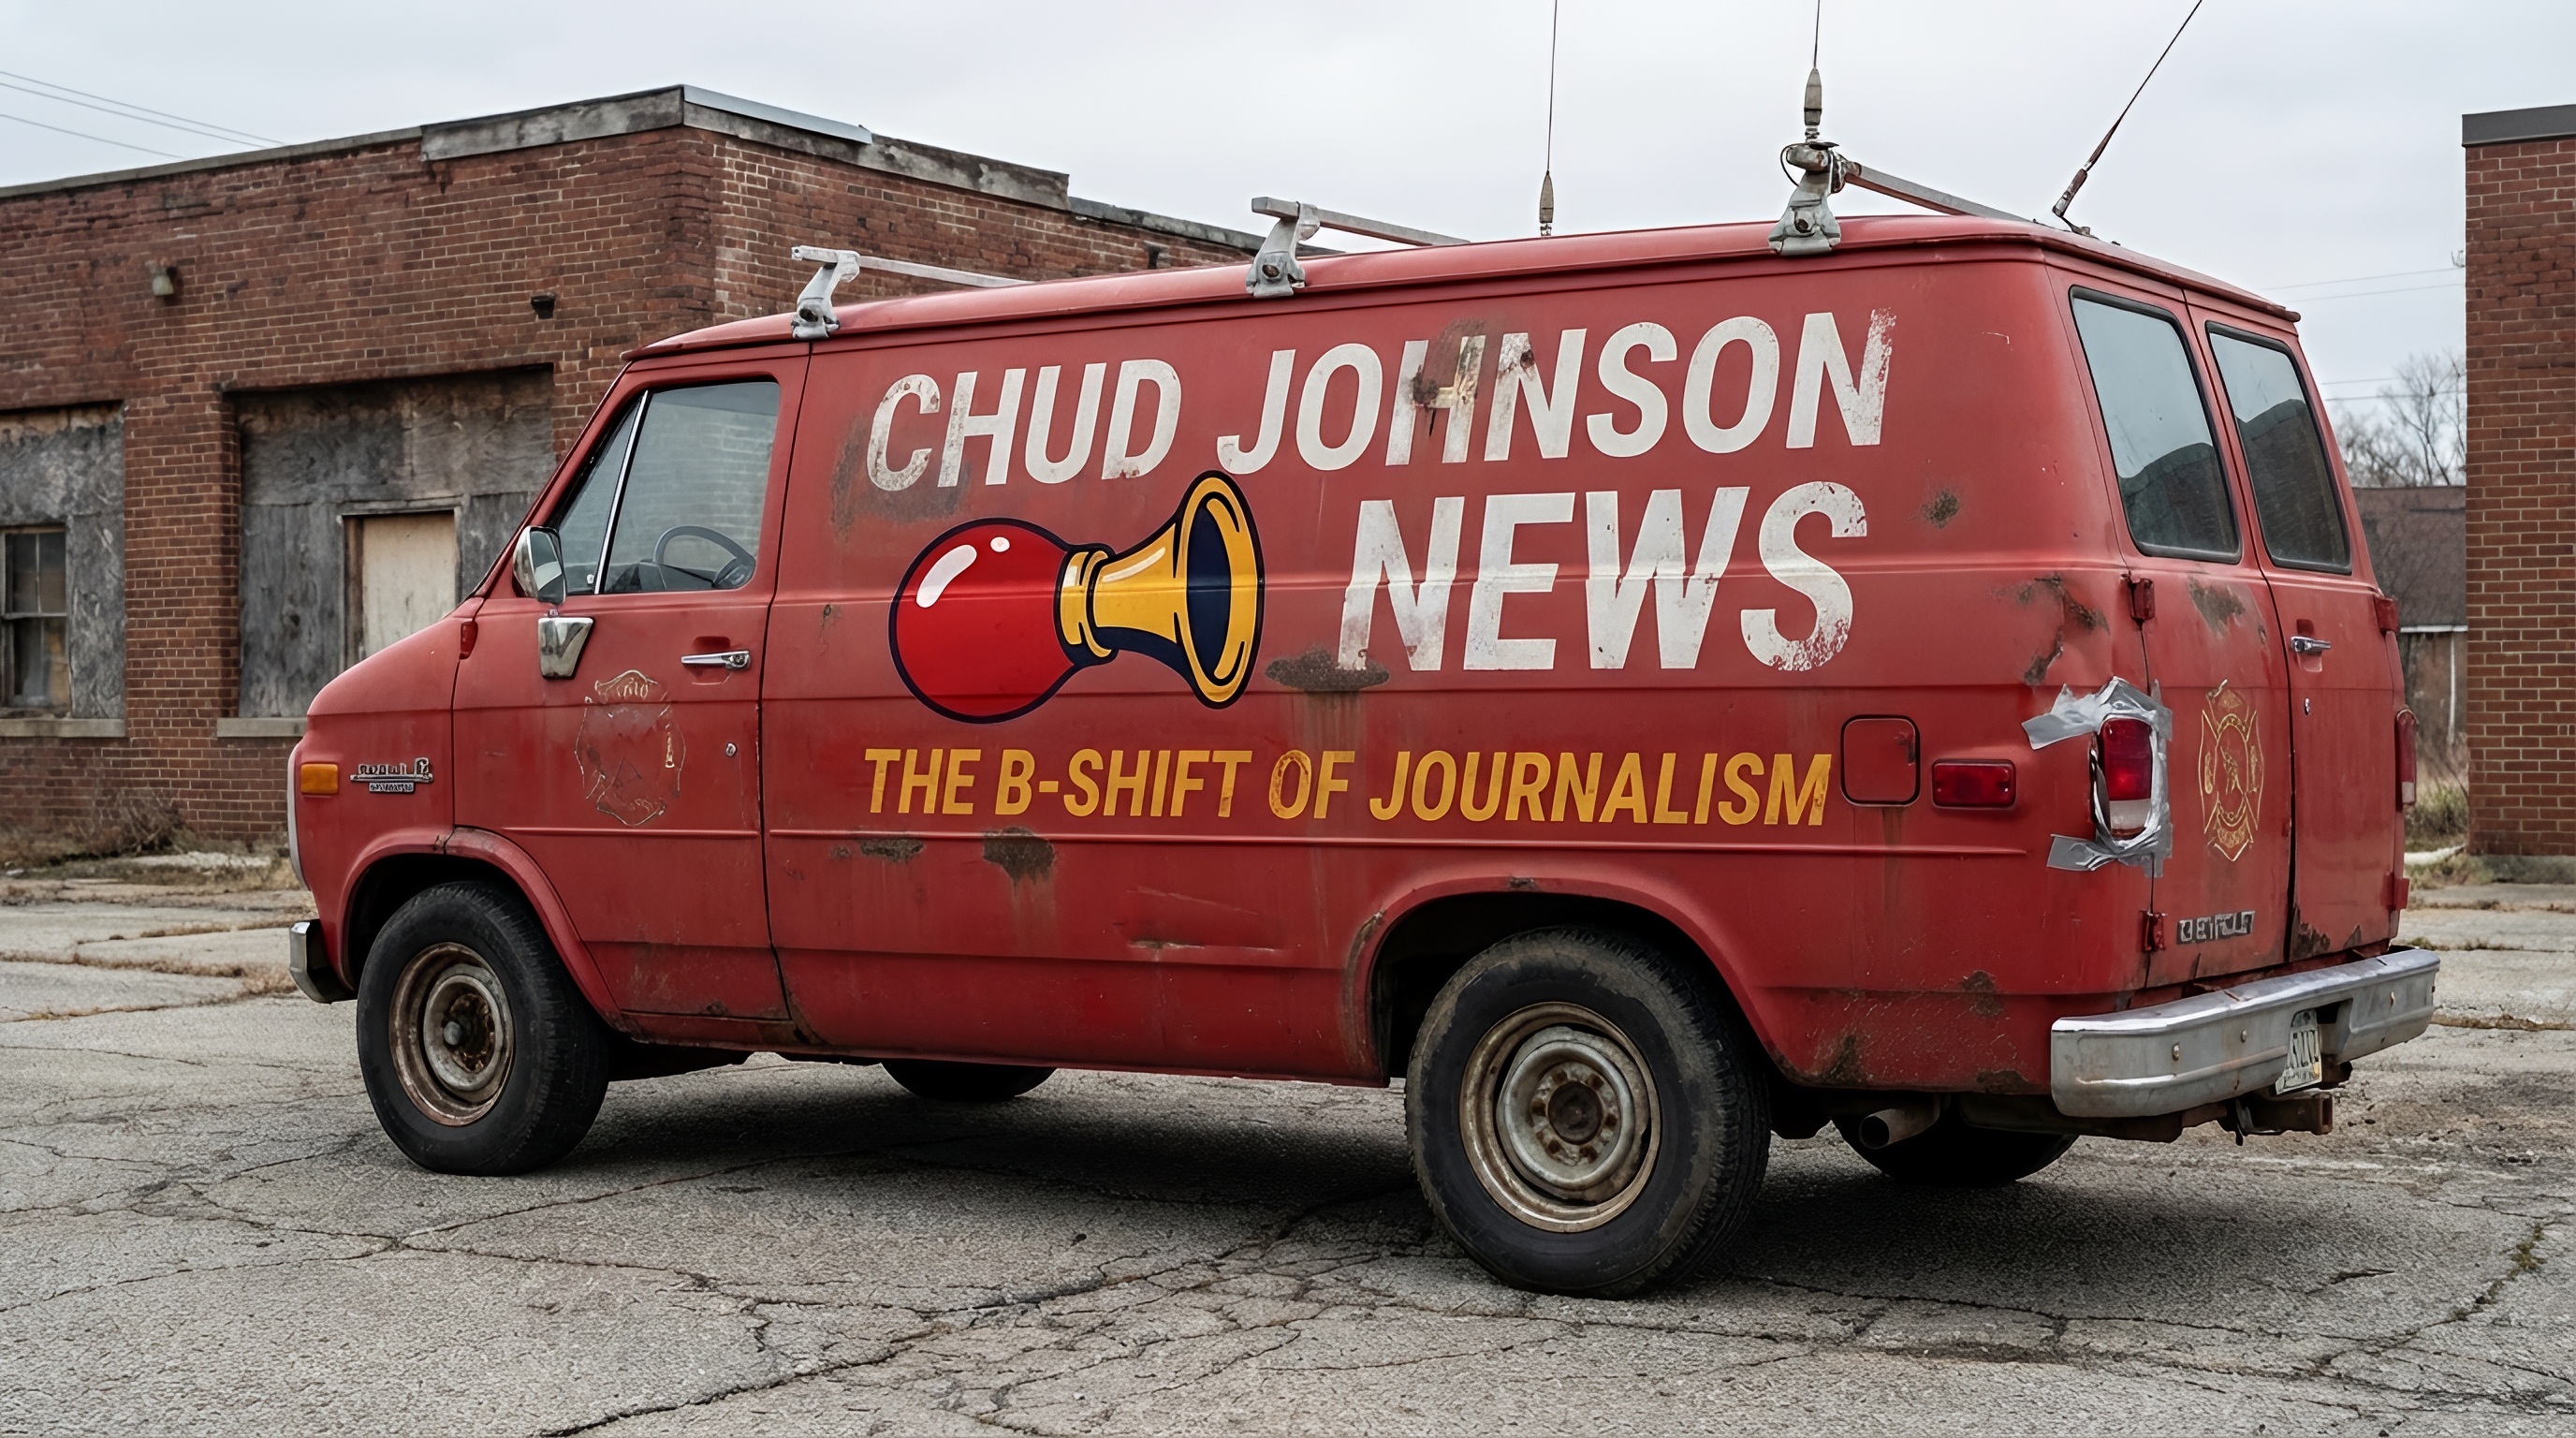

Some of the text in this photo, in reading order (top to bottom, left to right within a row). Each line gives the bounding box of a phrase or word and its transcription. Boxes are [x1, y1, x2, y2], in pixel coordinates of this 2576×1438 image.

[866, 309, 1896, 492] CHUD JOHNSON
[1338, 481, 1867, 672] NEWS
[864, 748, 1832, 827] THE B-SHIFT OF JOURNALISM
